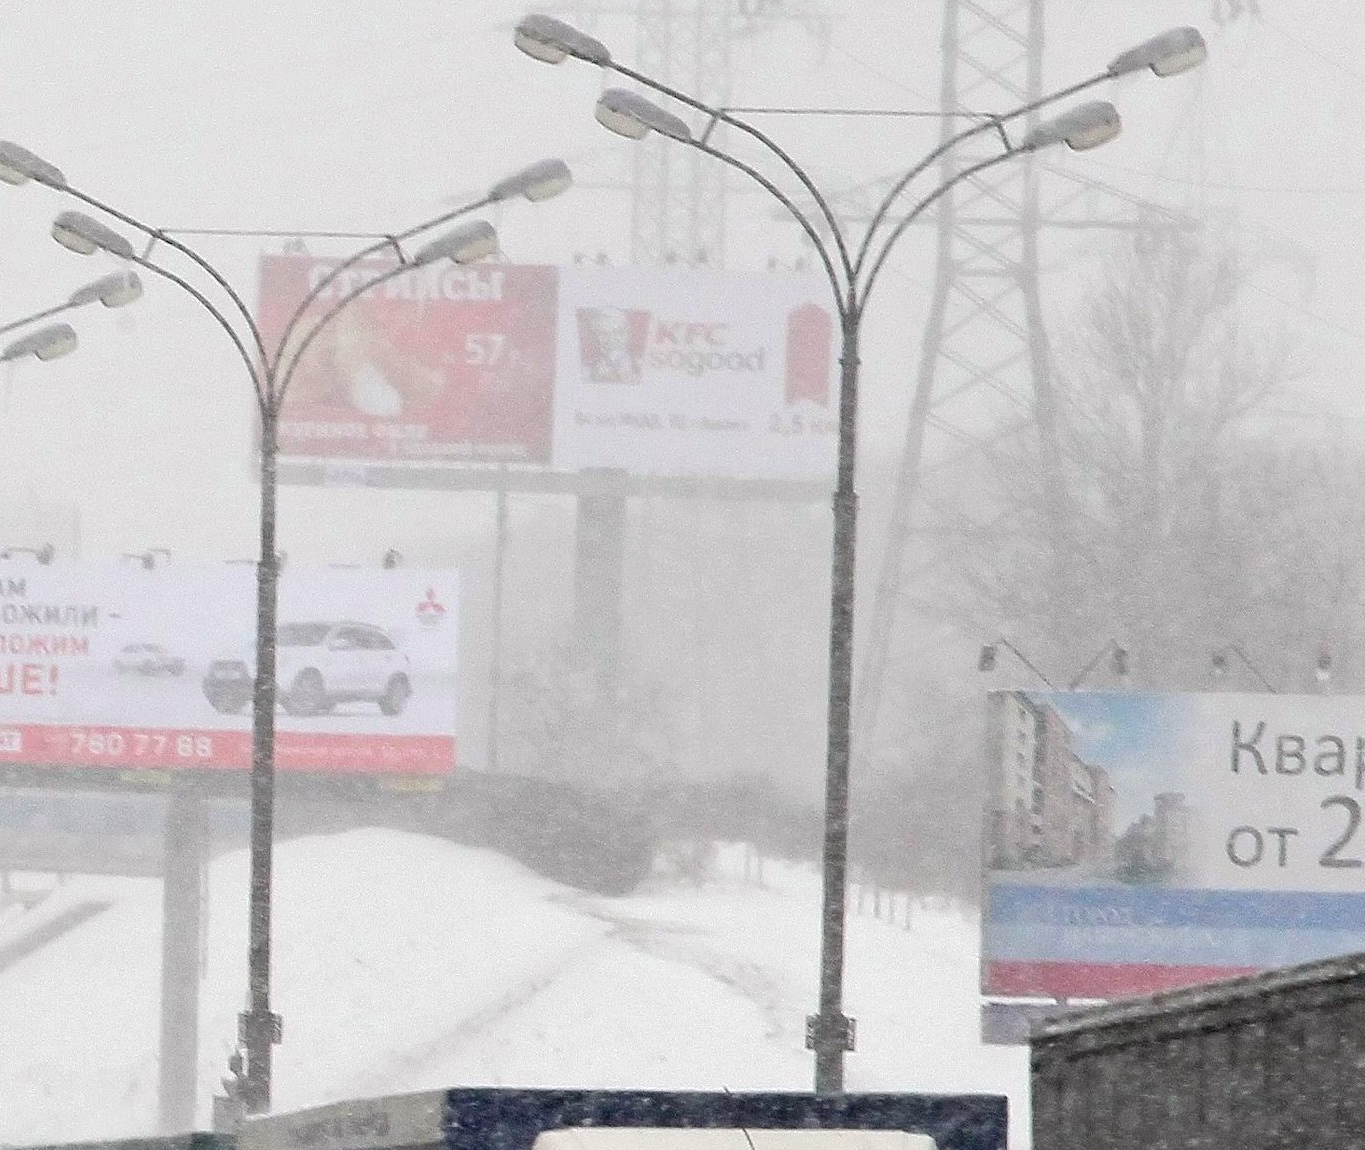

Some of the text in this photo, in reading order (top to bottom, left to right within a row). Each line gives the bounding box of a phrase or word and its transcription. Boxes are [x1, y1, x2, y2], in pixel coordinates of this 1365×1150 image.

[654, 321, 728, 346] KFC
[133, 733, 167, 756] 77
[1225, 825, 1299, 867] от
